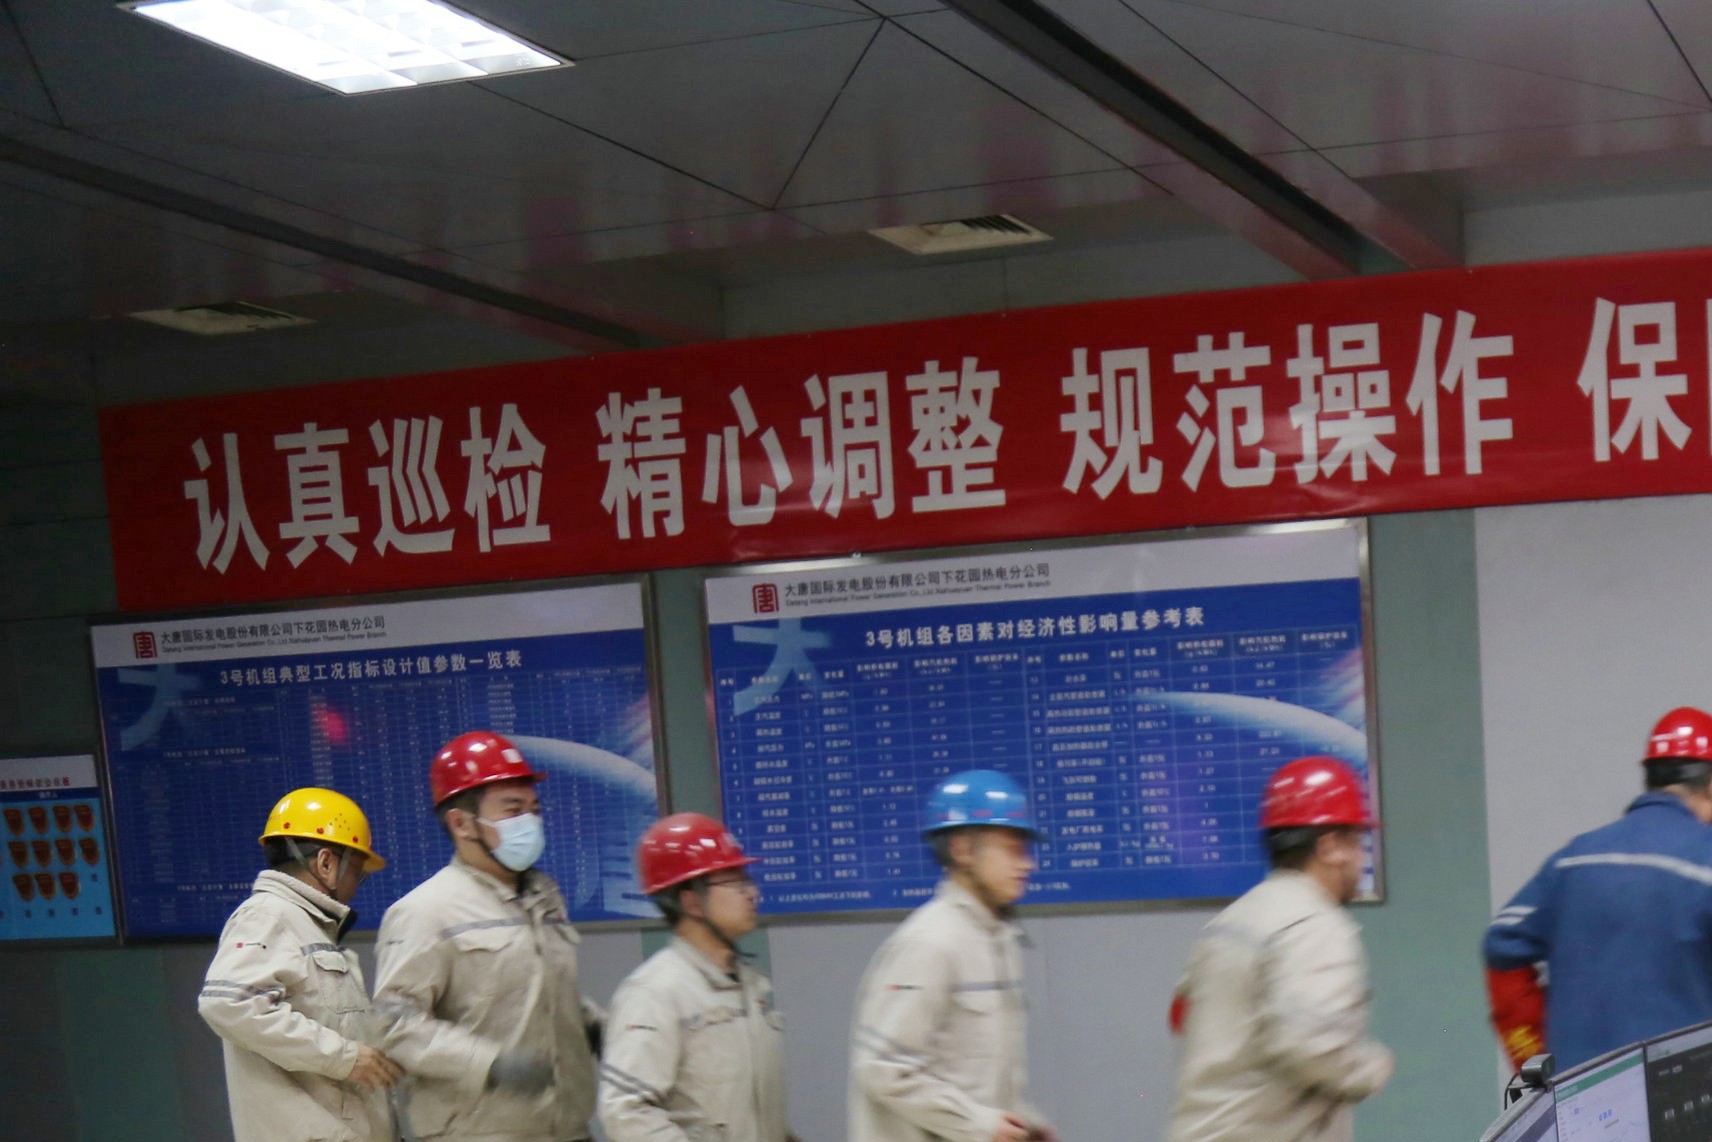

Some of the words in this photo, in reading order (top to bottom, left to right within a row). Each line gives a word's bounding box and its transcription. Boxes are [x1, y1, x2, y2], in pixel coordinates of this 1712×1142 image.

[185, 398, 552, 576] 认真巡检
[598, 353, 1007, 540] 精心调整
[1060, 307, 1515, 497] 规范操作
[866, 606, 1204, 648] 3号机组各因素对经济性影响量参考表
[220, 650, 523, 687] 3号机组典型工况指标设计值参数一览表
